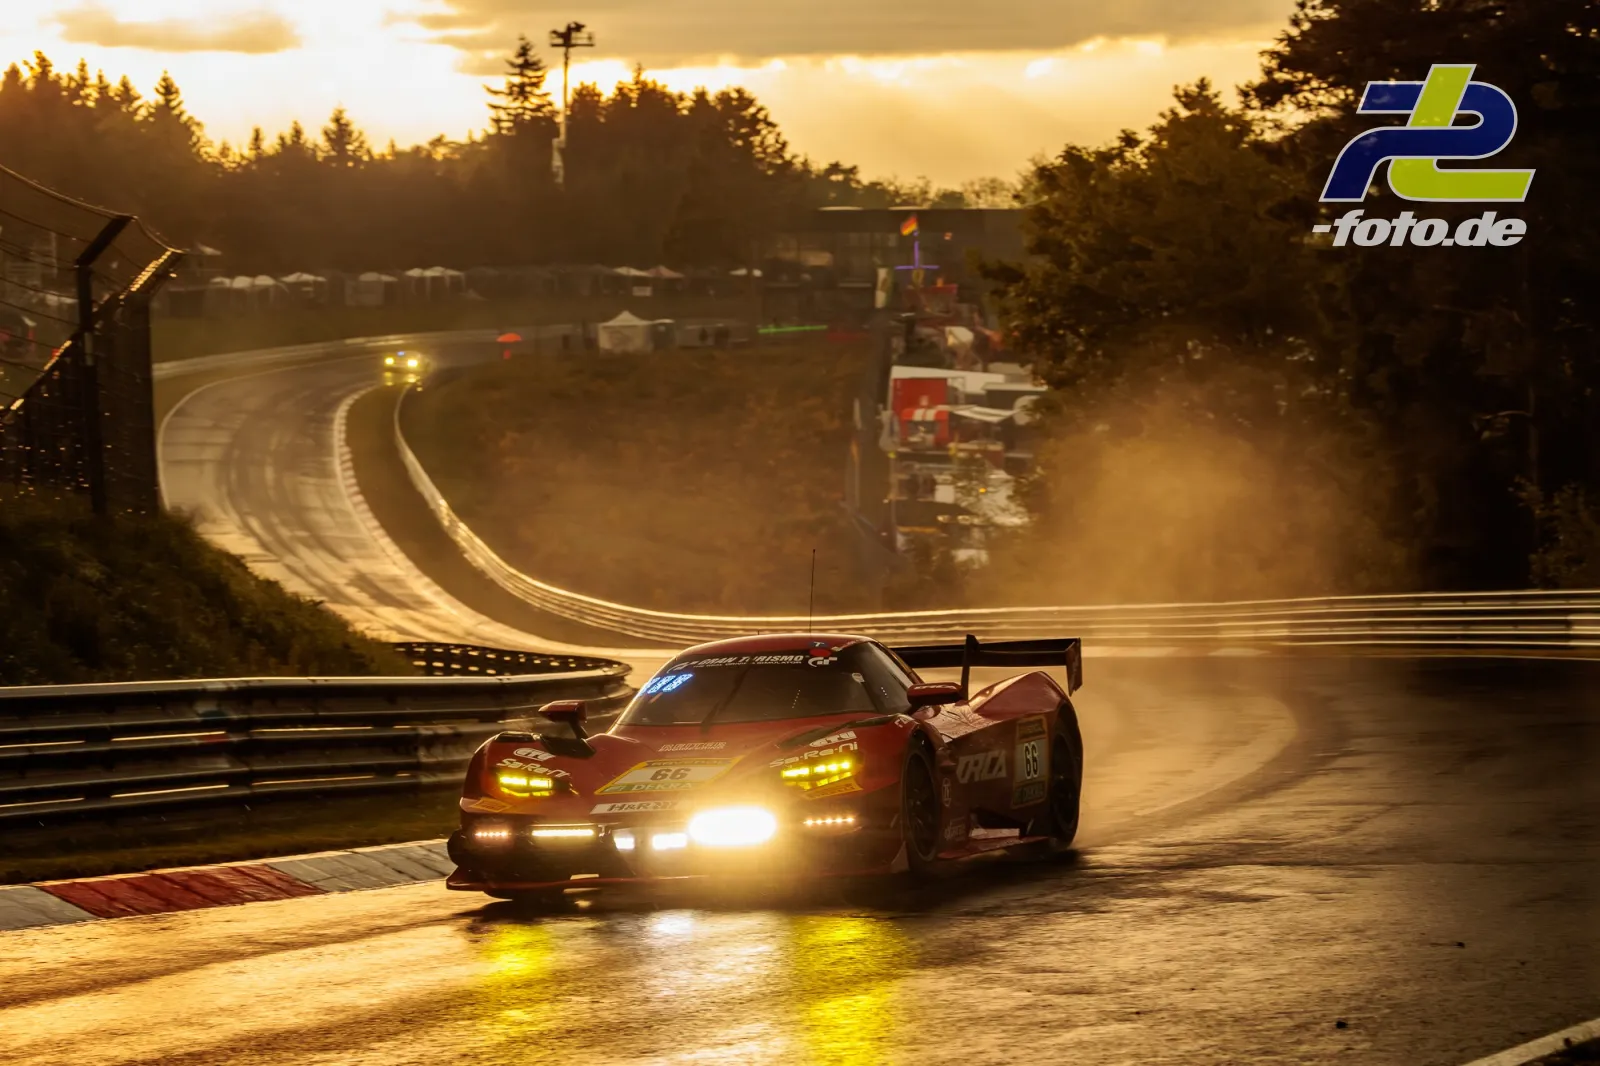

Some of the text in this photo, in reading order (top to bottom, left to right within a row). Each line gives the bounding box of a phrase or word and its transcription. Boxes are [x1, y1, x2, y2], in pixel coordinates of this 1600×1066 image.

[698, 656, 738, 666] GRAN
[1023, 741, 1039, 780] 66
[650, 767, 692, 781] 66
[631, 783, 693, 791] DEKRA
